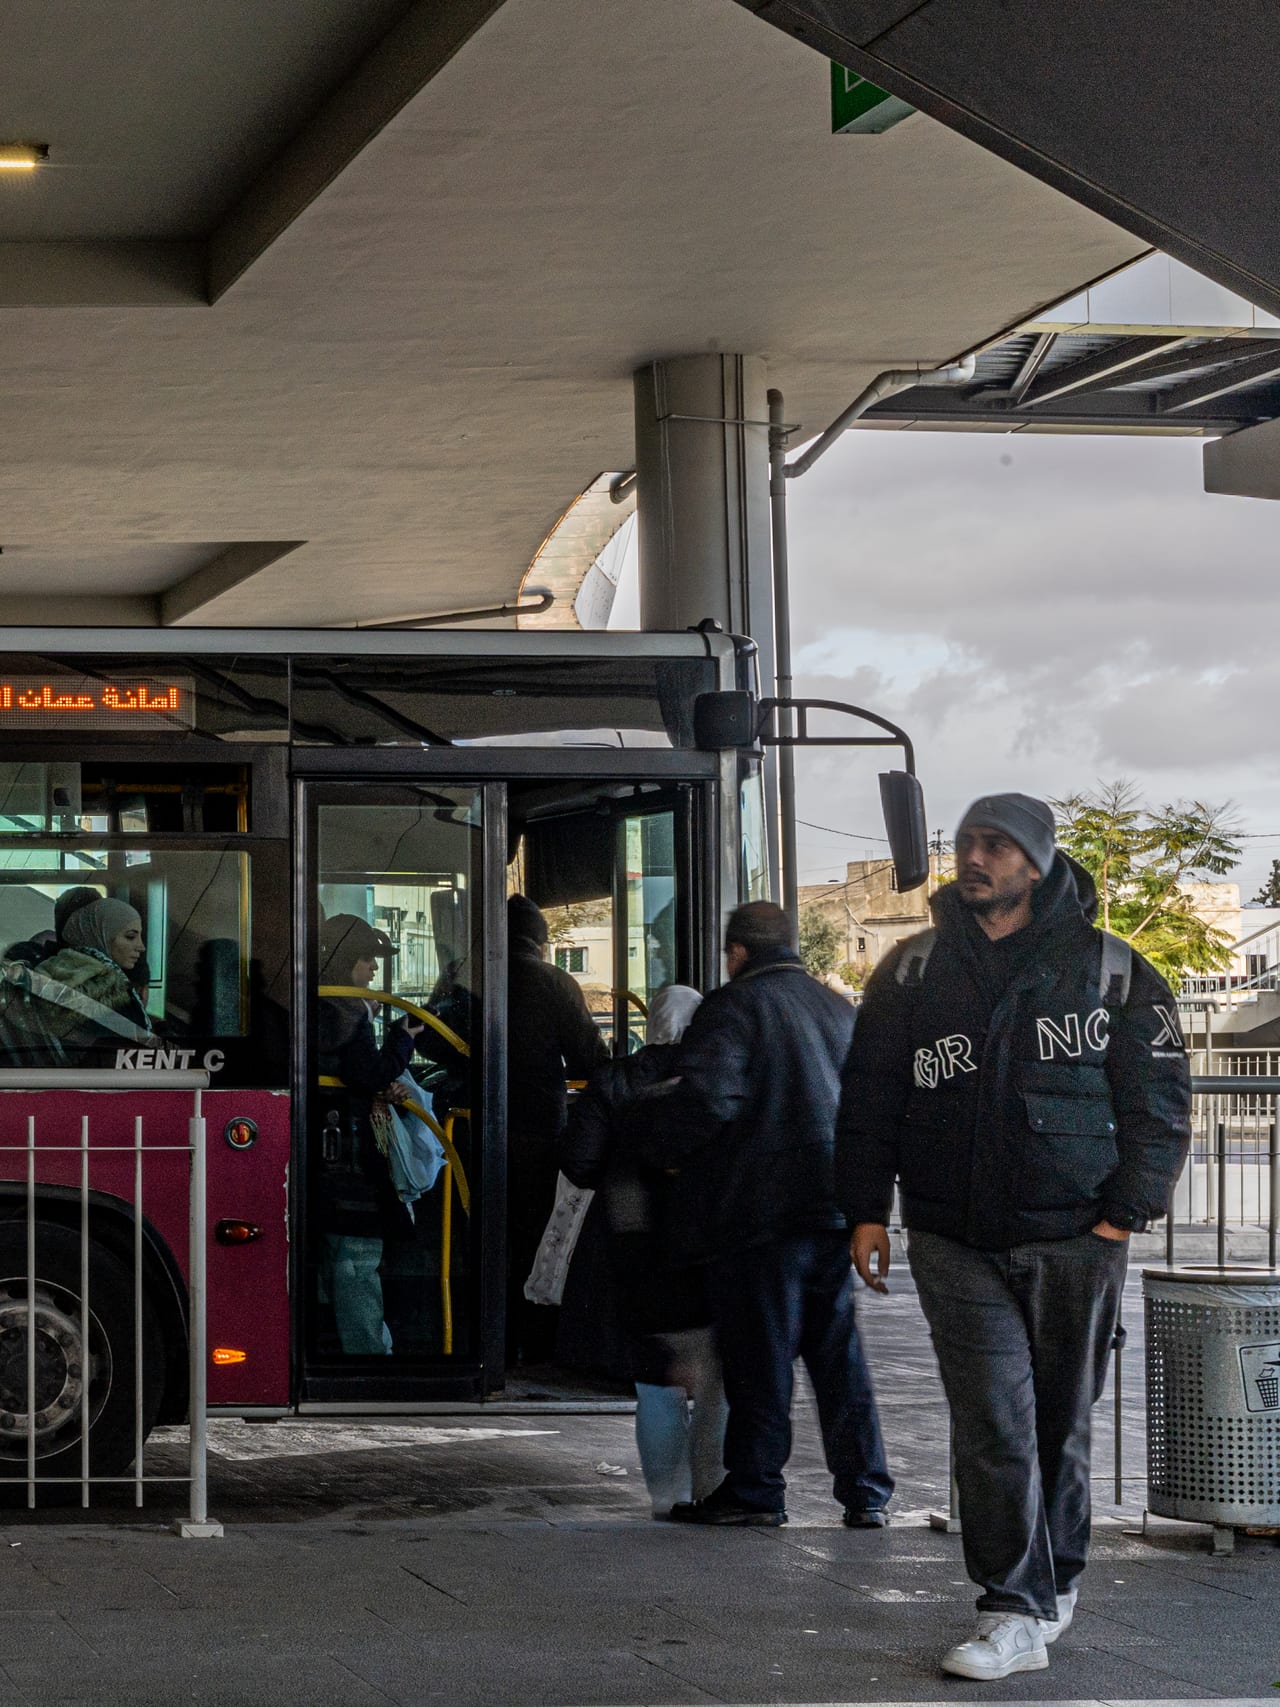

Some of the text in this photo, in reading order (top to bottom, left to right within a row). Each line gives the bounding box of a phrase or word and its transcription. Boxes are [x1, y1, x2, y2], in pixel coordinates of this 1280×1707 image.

[18, 686, 95, 709] عمان
[102, 686, 178, 709] امانة
[115, 1049, 225, 1072] KENT C
